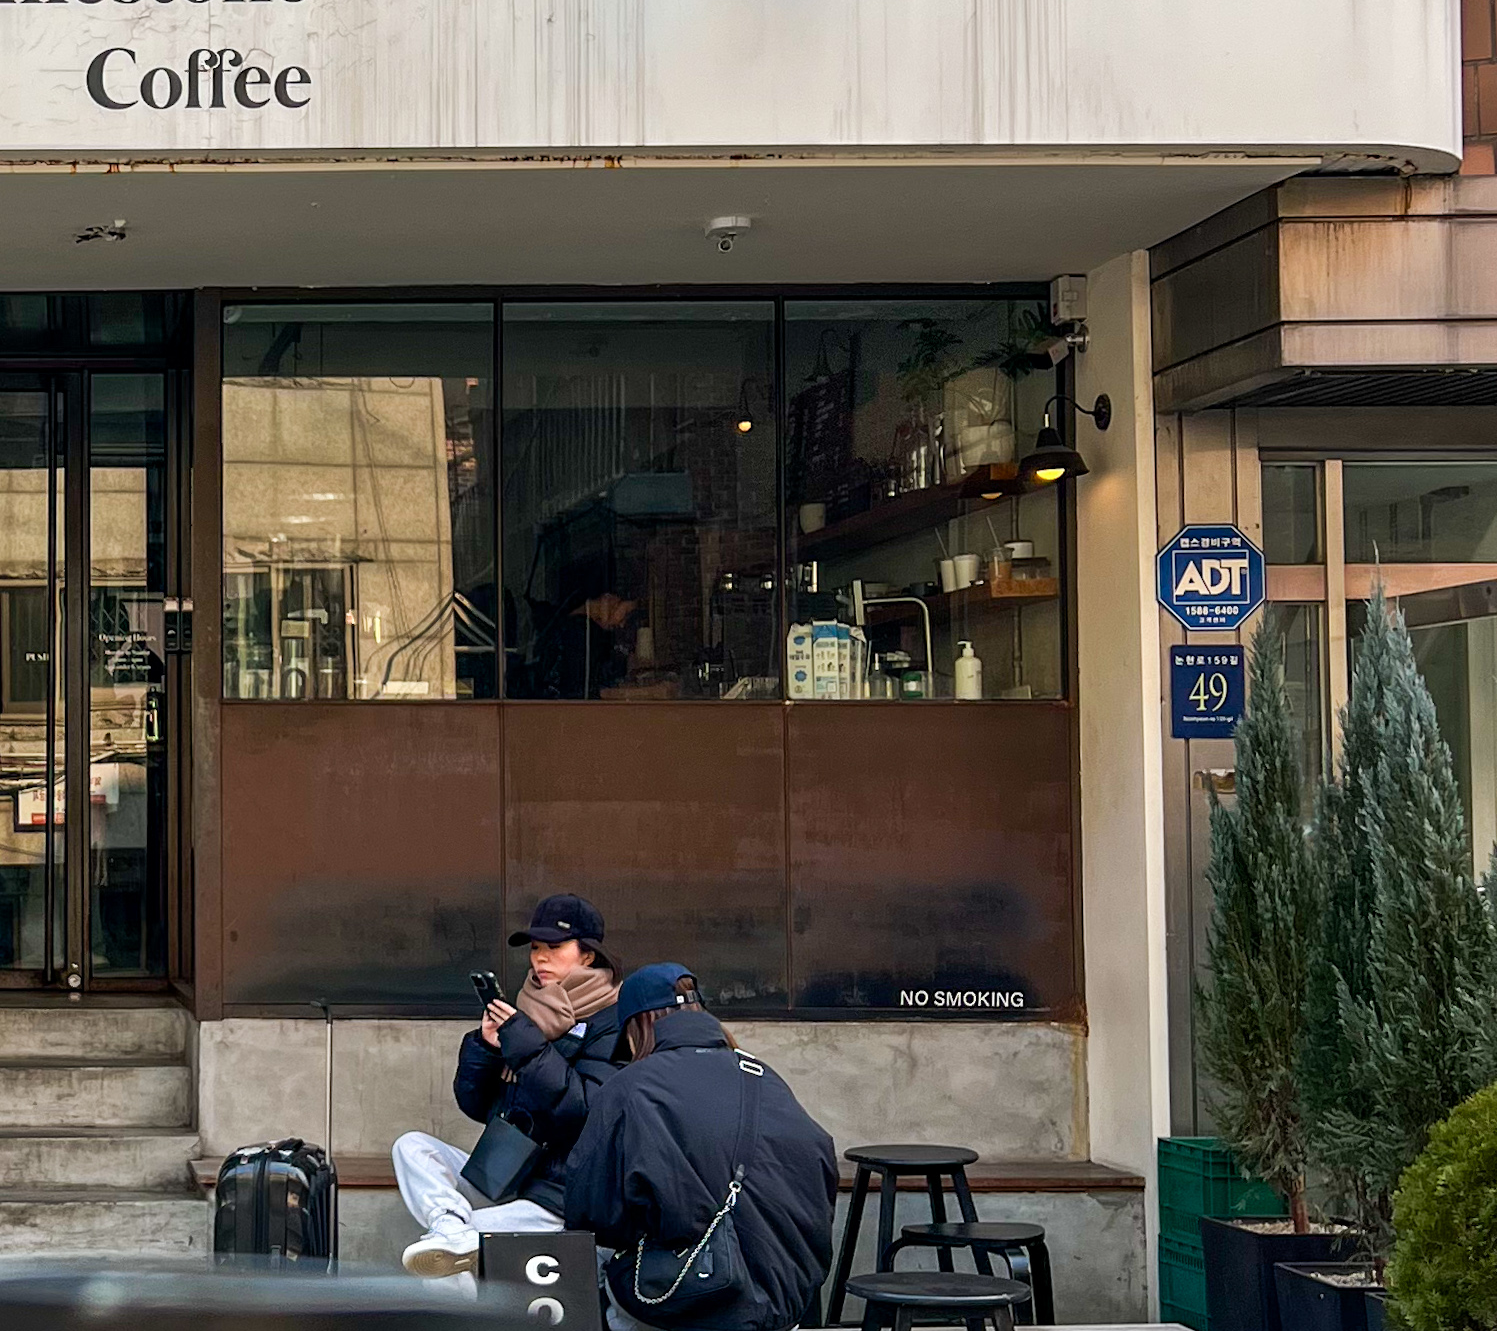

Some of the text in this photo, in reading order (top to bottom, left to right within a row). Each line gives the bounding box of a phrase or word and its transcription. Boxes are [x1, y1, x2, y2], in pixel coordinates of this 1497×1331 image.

[85, 47, 312, 110] Coffee
[1174, 558, 1249, 596] ADT
[1188, 672, 1228, 712] 49
[900, 989, 1024, 1008] NO SMOKING
